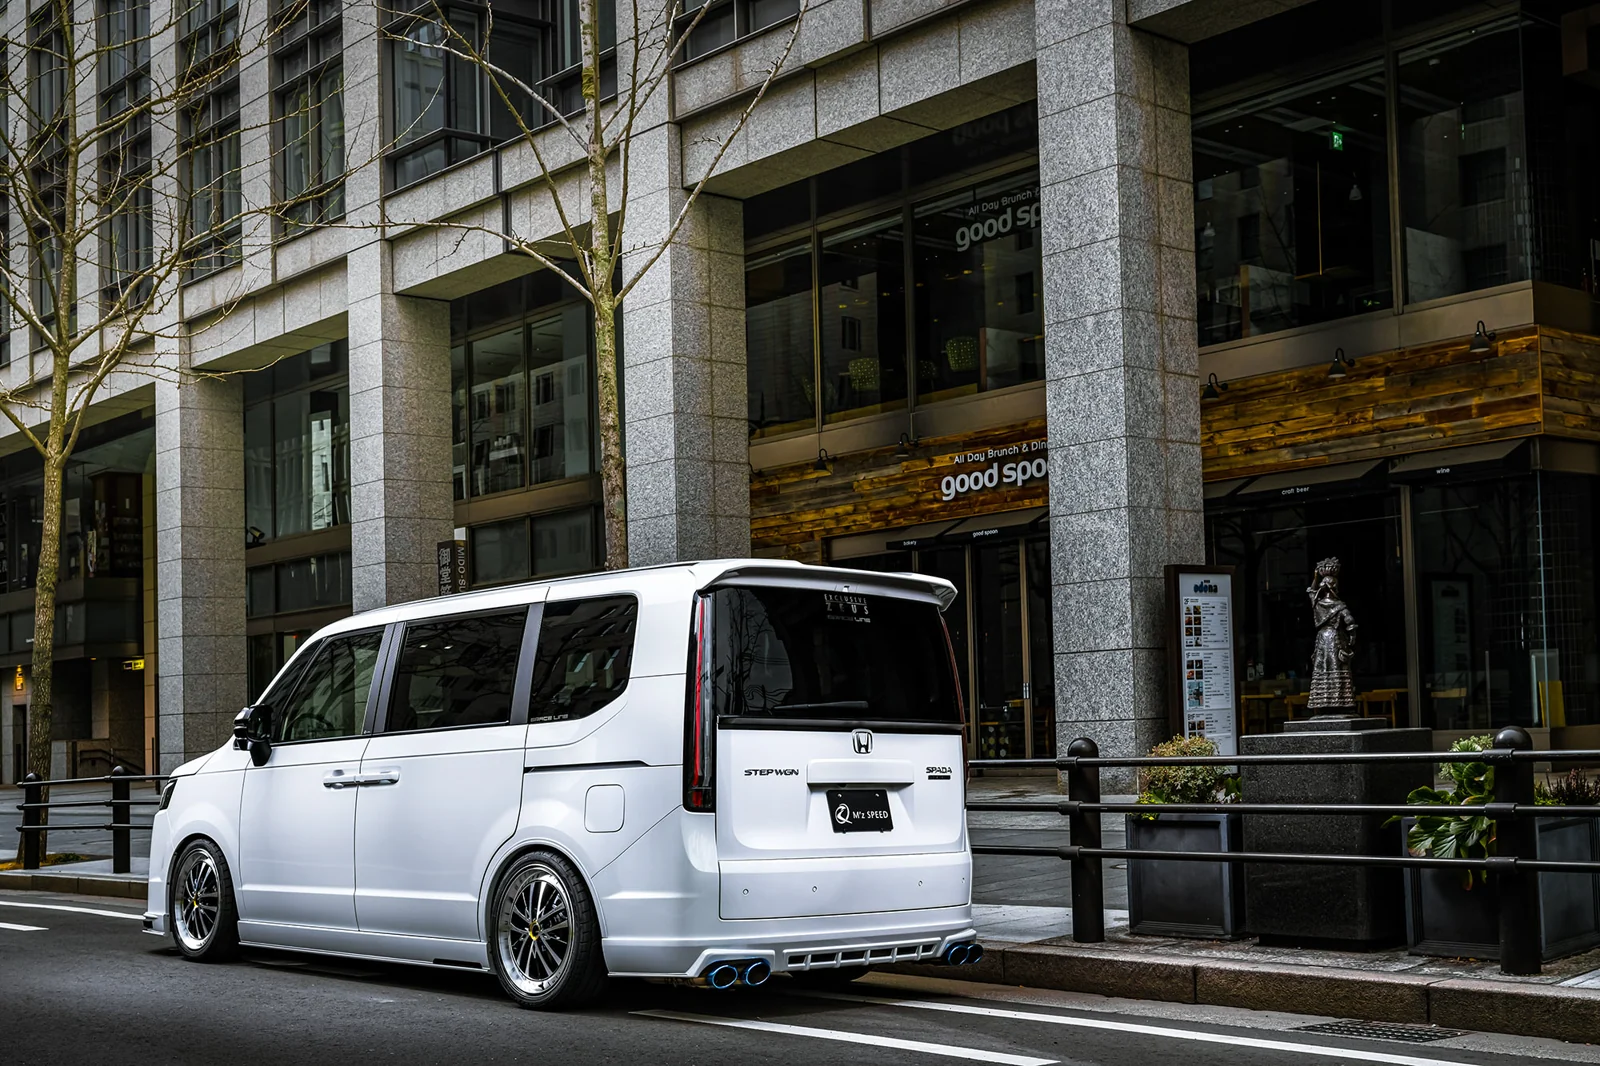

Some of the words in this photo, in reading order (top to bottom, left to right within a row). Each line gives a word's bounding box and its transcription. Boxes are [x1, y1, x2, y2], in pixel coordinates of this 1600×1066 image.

[968, 204, 980, 216] All
[981, 200, 1000, 212] Day
[1001, 190, 1033, 206] Brunch
[955, 207, 1012, 252] good
[953, 455, 965, 464] All
[967, 452, 985, 462] Day
[987, 445, 1019, 459] Brunch
[1022, 443, 1029, 453] &
[1031, 440, 1048, 451] Din
[941, 462, 999, 501] good
[1002, 458, 1048, 486] spo
[972, 529, 984, 538] good
[984, 528, 999, 536] spoon
[823, 593, 867, 604] EXCLUSIVE
[825, 602, 869, 615] ZEUS
[925, 766, 953, 774] SPADA
[852, 810, 866, 819] M'z
[866, 810, 889, 819] SPEED
